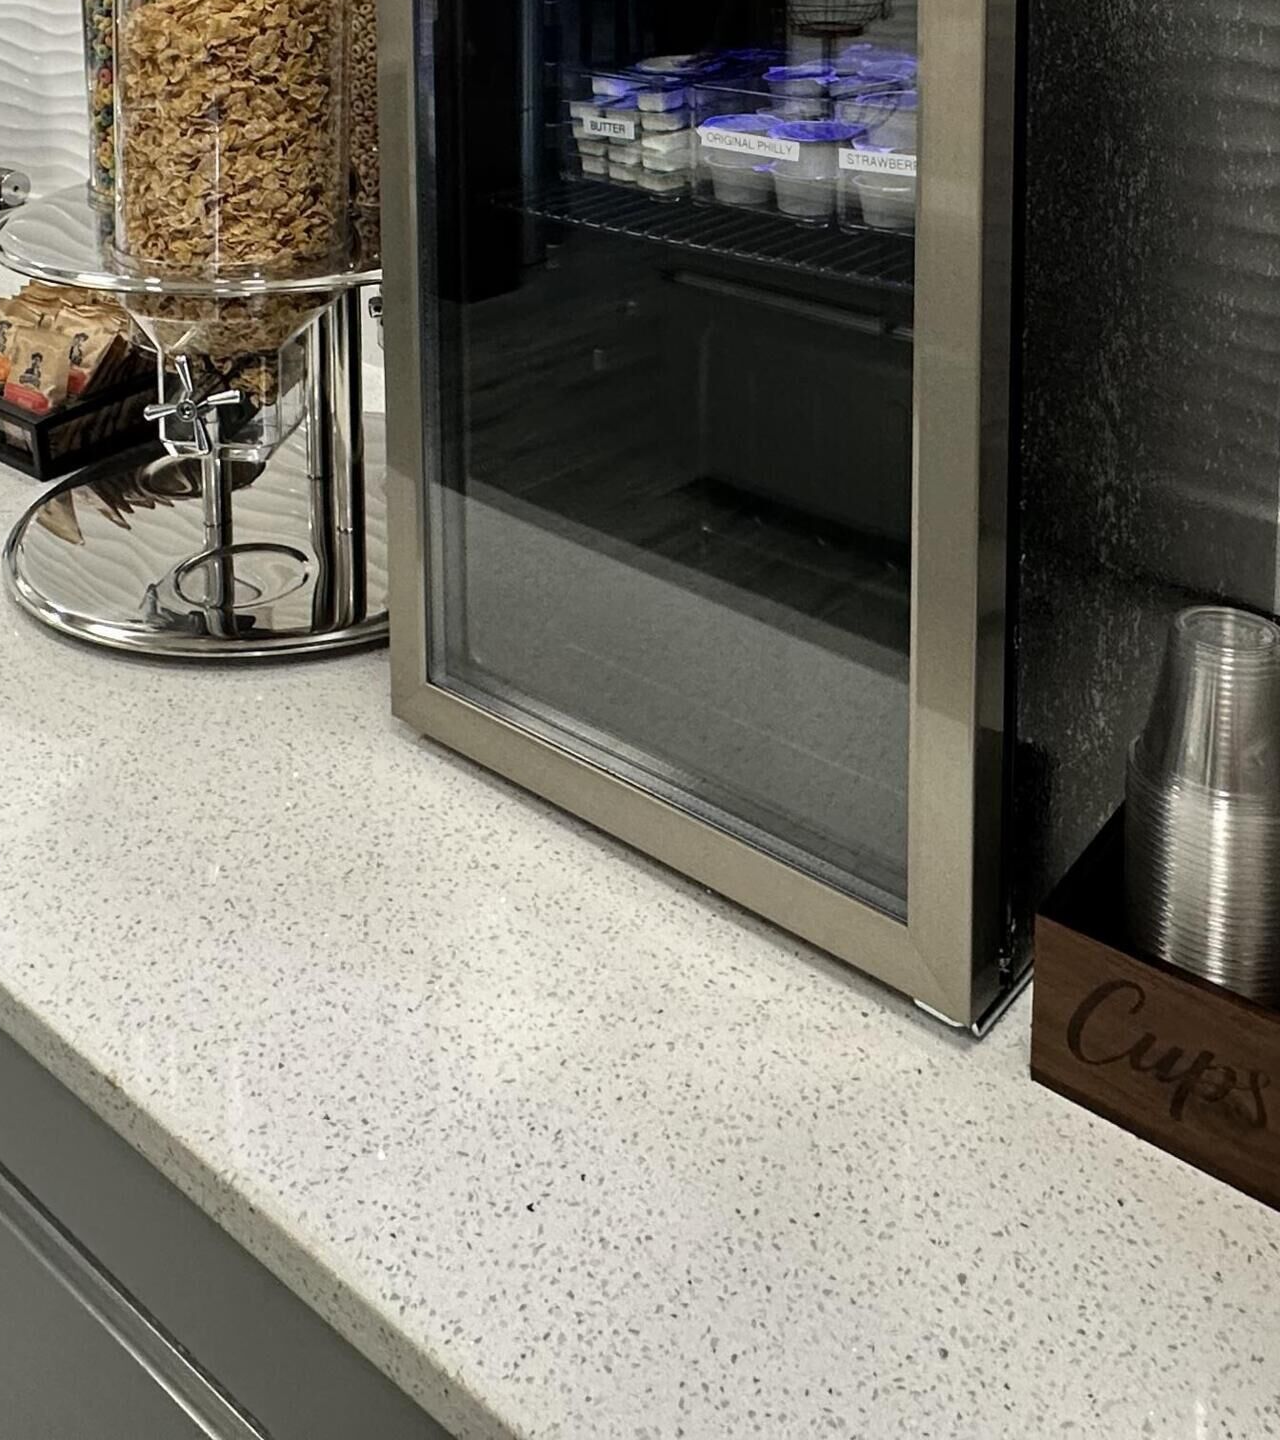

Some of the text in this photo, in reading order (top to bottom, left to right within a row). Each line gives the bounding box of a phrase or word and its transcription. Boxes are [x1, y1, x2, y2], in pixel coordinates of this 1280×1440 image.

[590, 121, 625, 134] BUTTER
[706, 132, 793, 156] ORIGINAL PHILLY
[1067, 979, 1272, 1129] Cups
